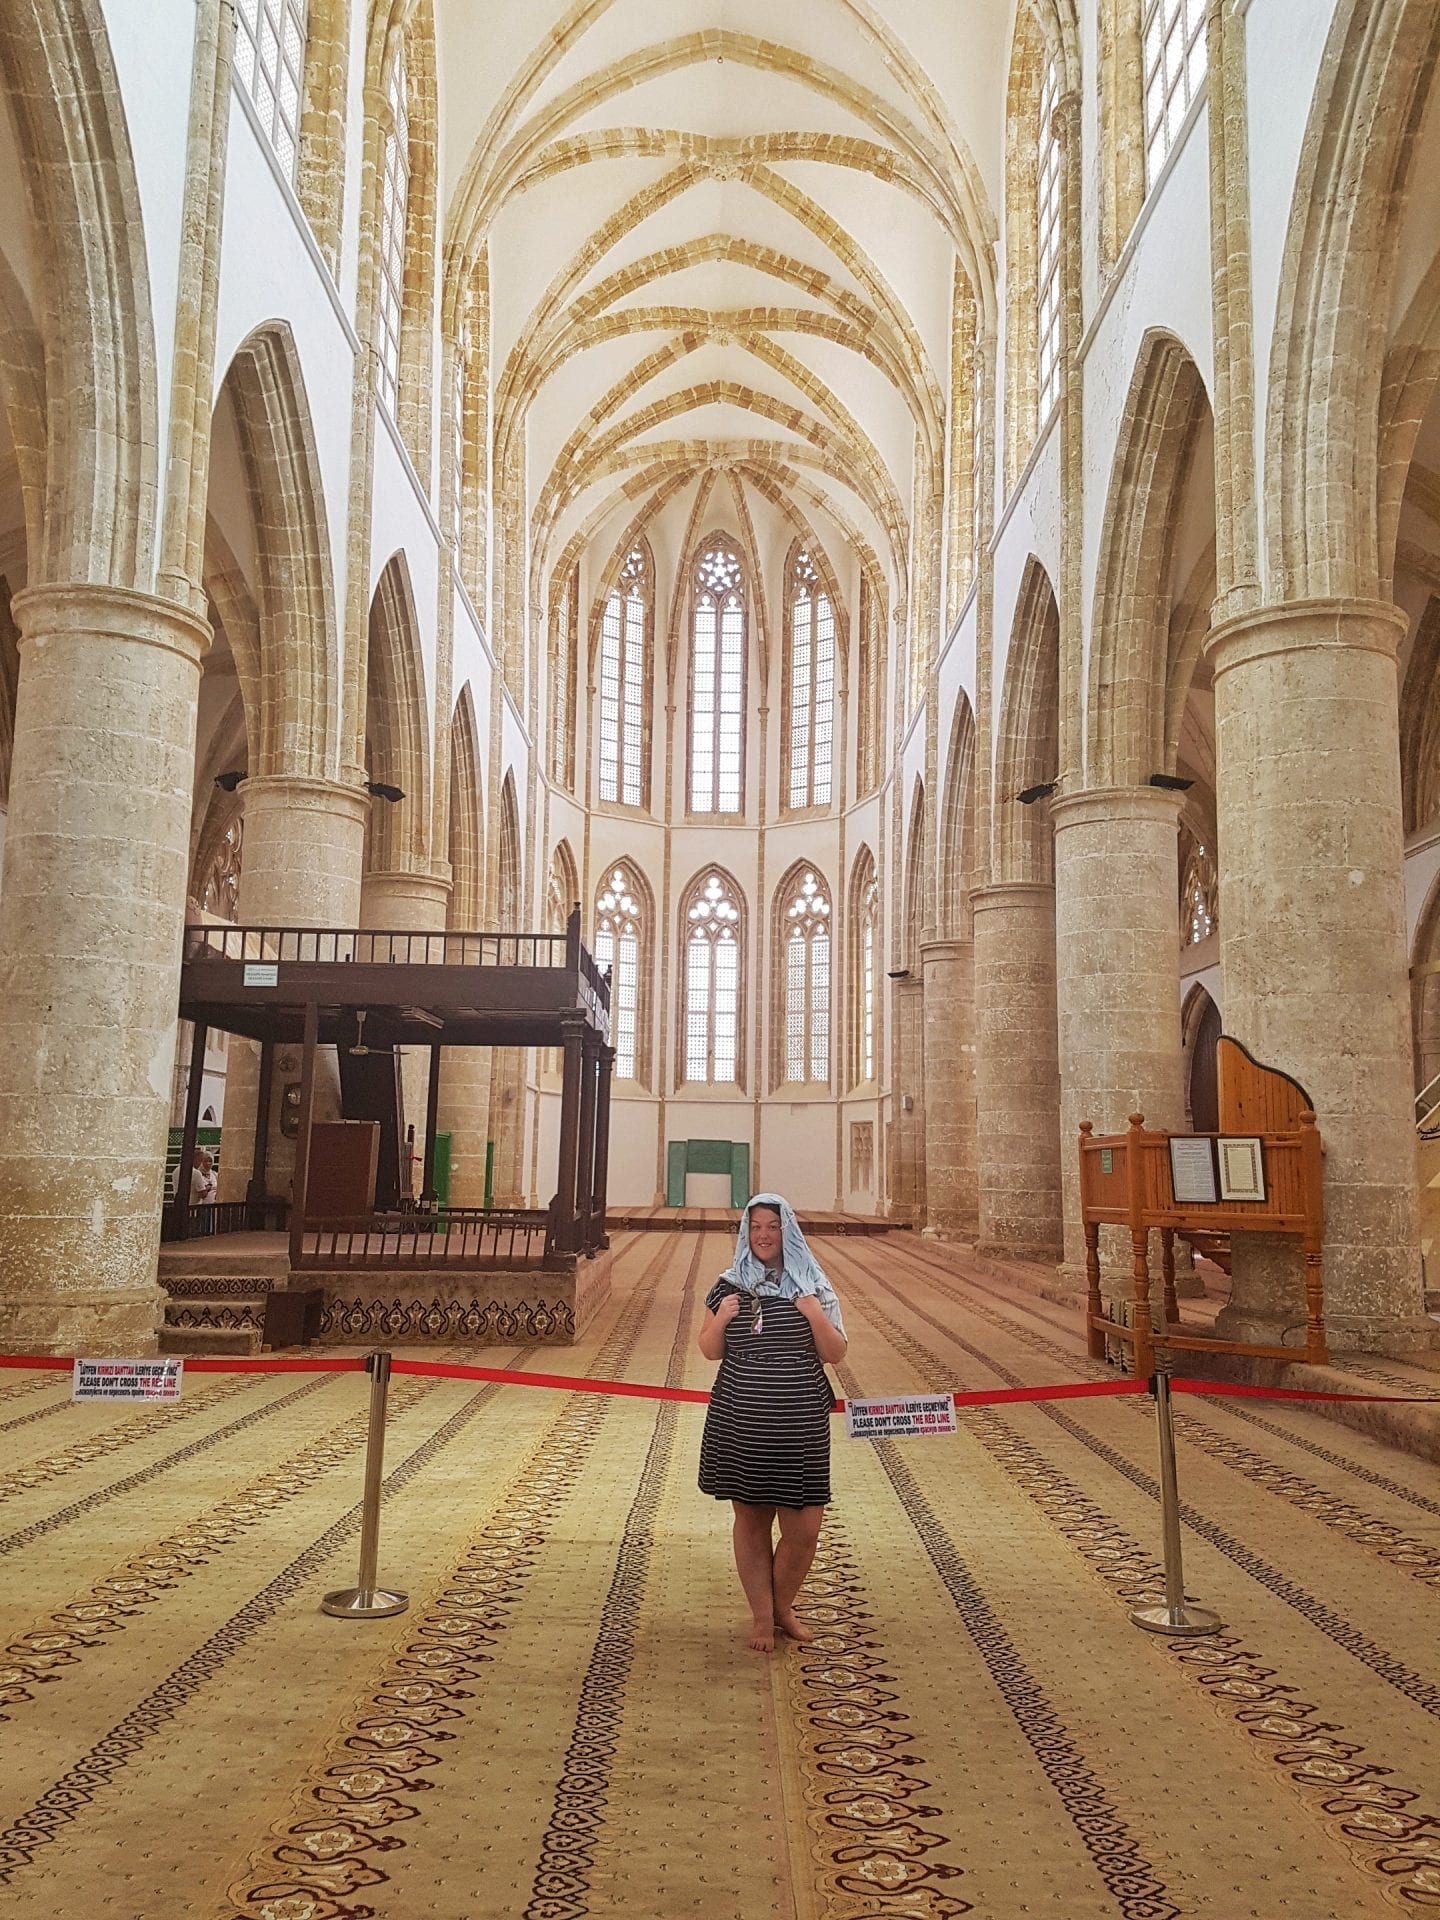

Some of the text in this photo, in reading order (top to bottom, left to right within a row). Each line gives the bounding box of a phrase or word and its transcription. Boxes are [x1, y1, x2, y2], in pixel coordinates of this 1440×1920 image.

[80, 1378, 100, 1387] PLEASE
[101, 1378, 119, 1387] DON'T
[120, 1378, 138, 1387] CROSS
[140, 1378, 150, 1387] THE
[164, 1378, 176, 1387] LINE
[852, 1413, 950, 1428] PLEASE DON'T CROSS THE RED LINE
